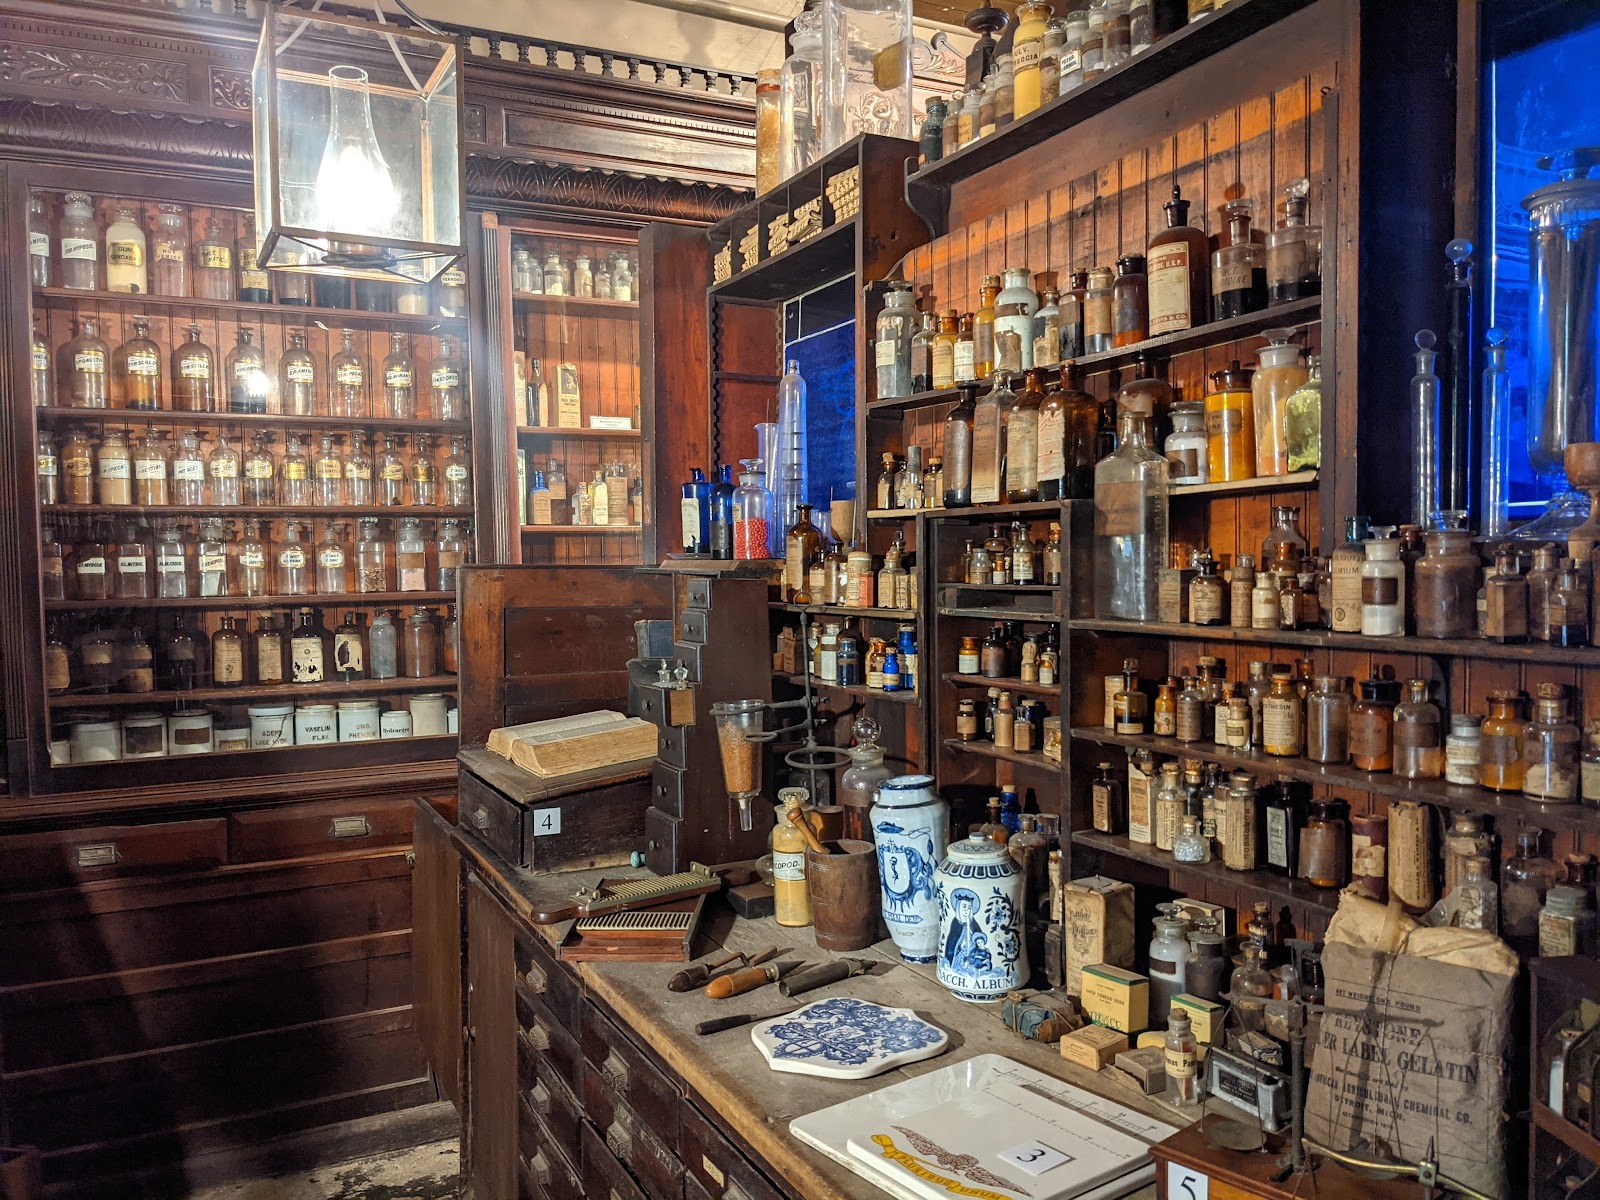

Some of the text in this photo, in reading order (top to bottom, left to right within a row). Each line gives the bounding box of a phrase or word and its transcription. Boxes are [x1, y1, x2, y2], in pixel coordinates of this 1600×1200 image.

[541, 814, 553, 830] 4
[938, 968, 1014, 990] SACCH. ALBUM
[1342, 1037, 1391, 1067] LABEL
[1396, 1051, 1479, 1085] GELATIN
[1403, 1099, 1451, 1120] CHEMICAL
[1456, 1111, 1473, 1124] CO.
[1016, 1148, 1046, 1163] 3
[1181, 1175, 1196, 1200] 5
